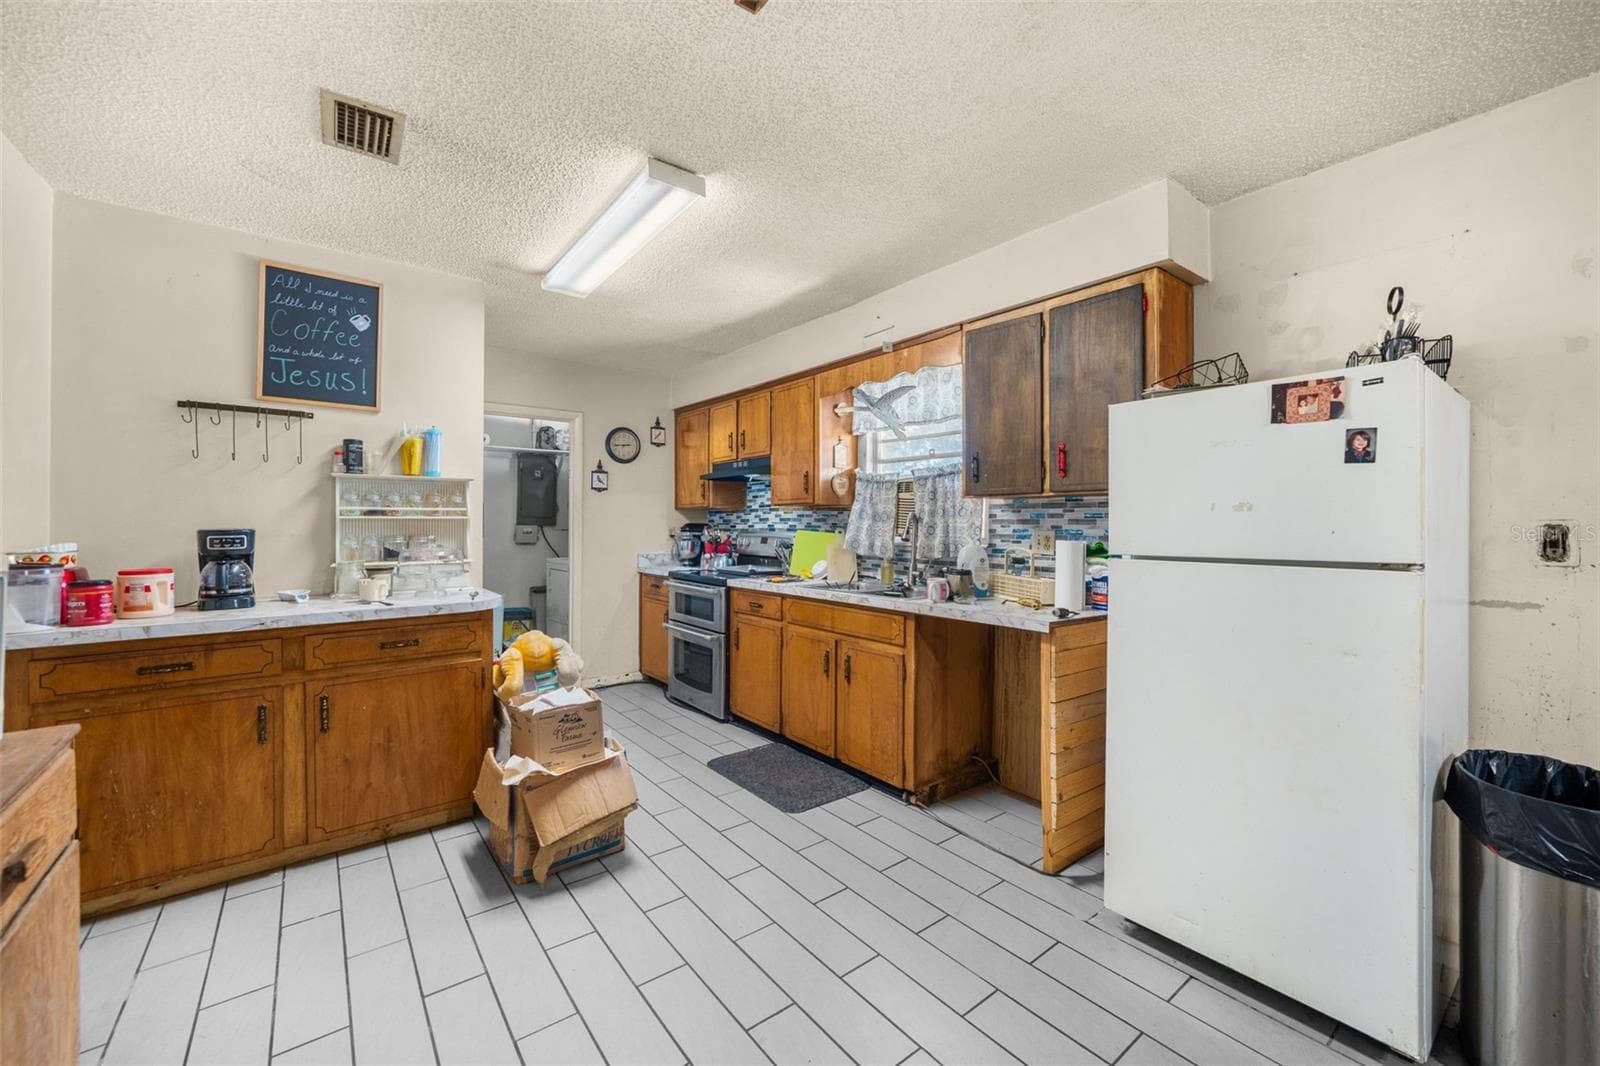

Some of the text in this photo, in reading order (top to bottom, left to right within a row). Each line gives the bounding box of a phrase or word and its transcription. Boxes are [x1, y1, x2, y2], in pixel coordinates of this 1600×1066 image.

[271, 274, 301, 289] All
[305, 282, 312, 294] I
[314, 289, 340, 298] need
[270, 293, 338, 316] little bit of
[270, 308, 361, 348] Coffee
[268, 343, 362, 365] and a whole lot of
[269, 356, 368, 395] Jesus!
